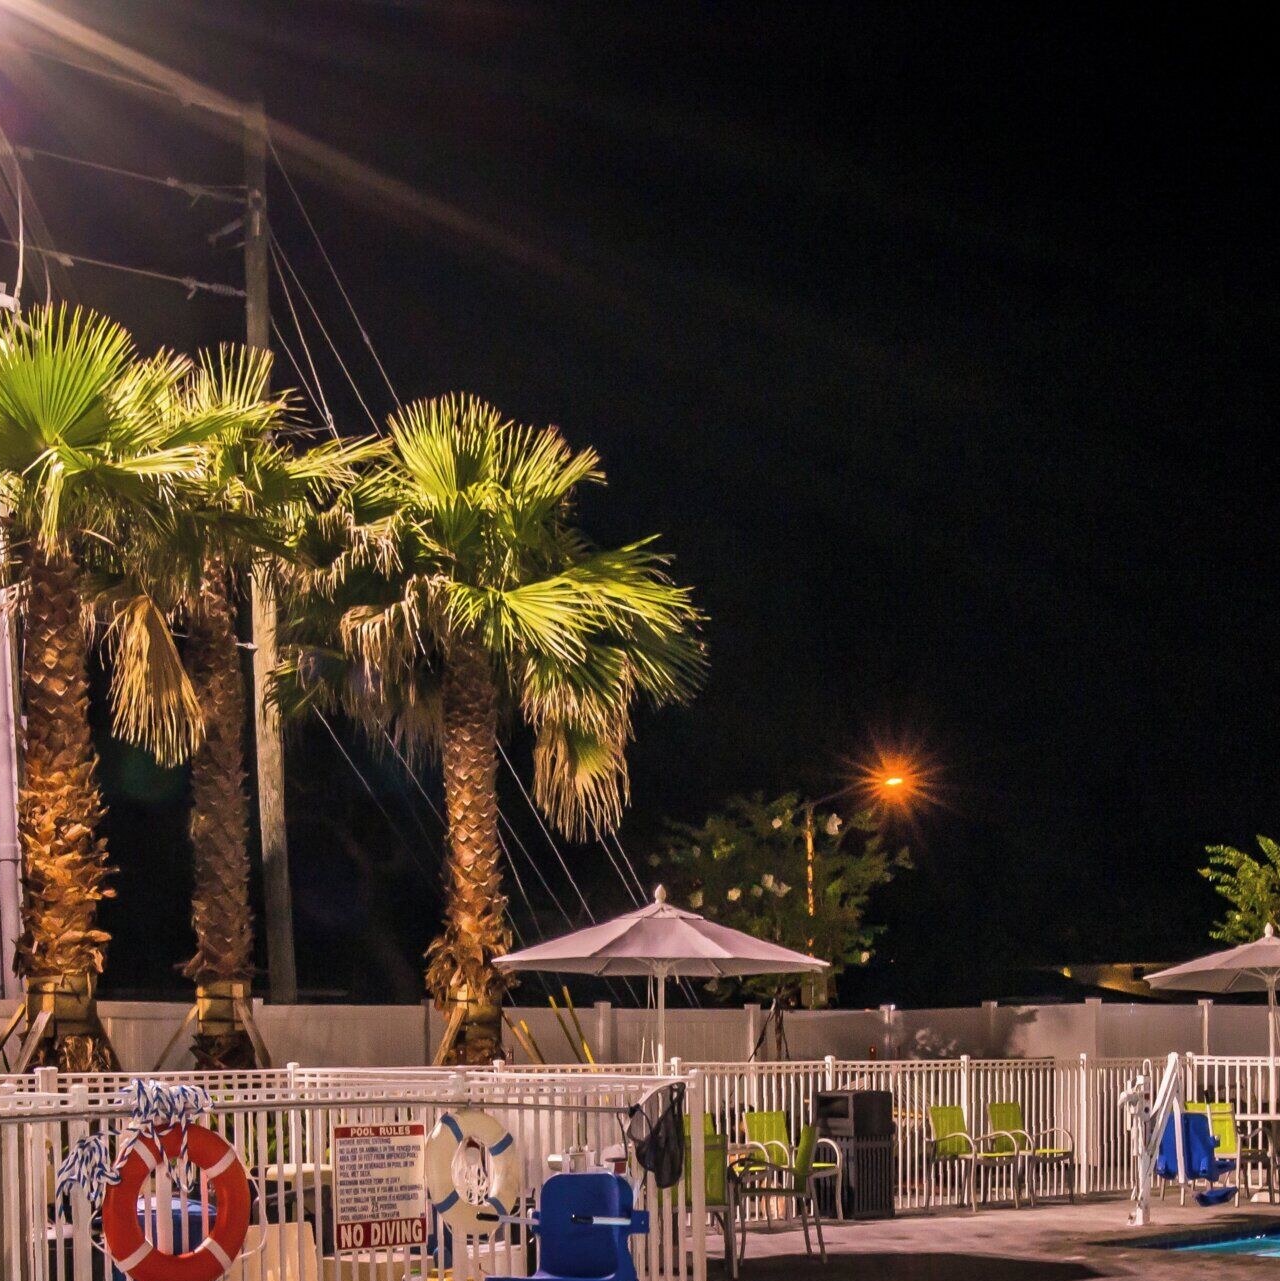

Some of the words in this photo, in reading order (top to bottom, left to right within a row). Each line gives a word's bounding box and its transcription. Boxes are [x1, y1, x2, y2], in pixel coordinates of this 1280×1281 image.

[350, 1127, 375, 1137] POOL
[379, 1125, 411, 1136] RULES
[340, 1223, 364, 1249] NO
[370, 1219, 424, 1247] DIVING
